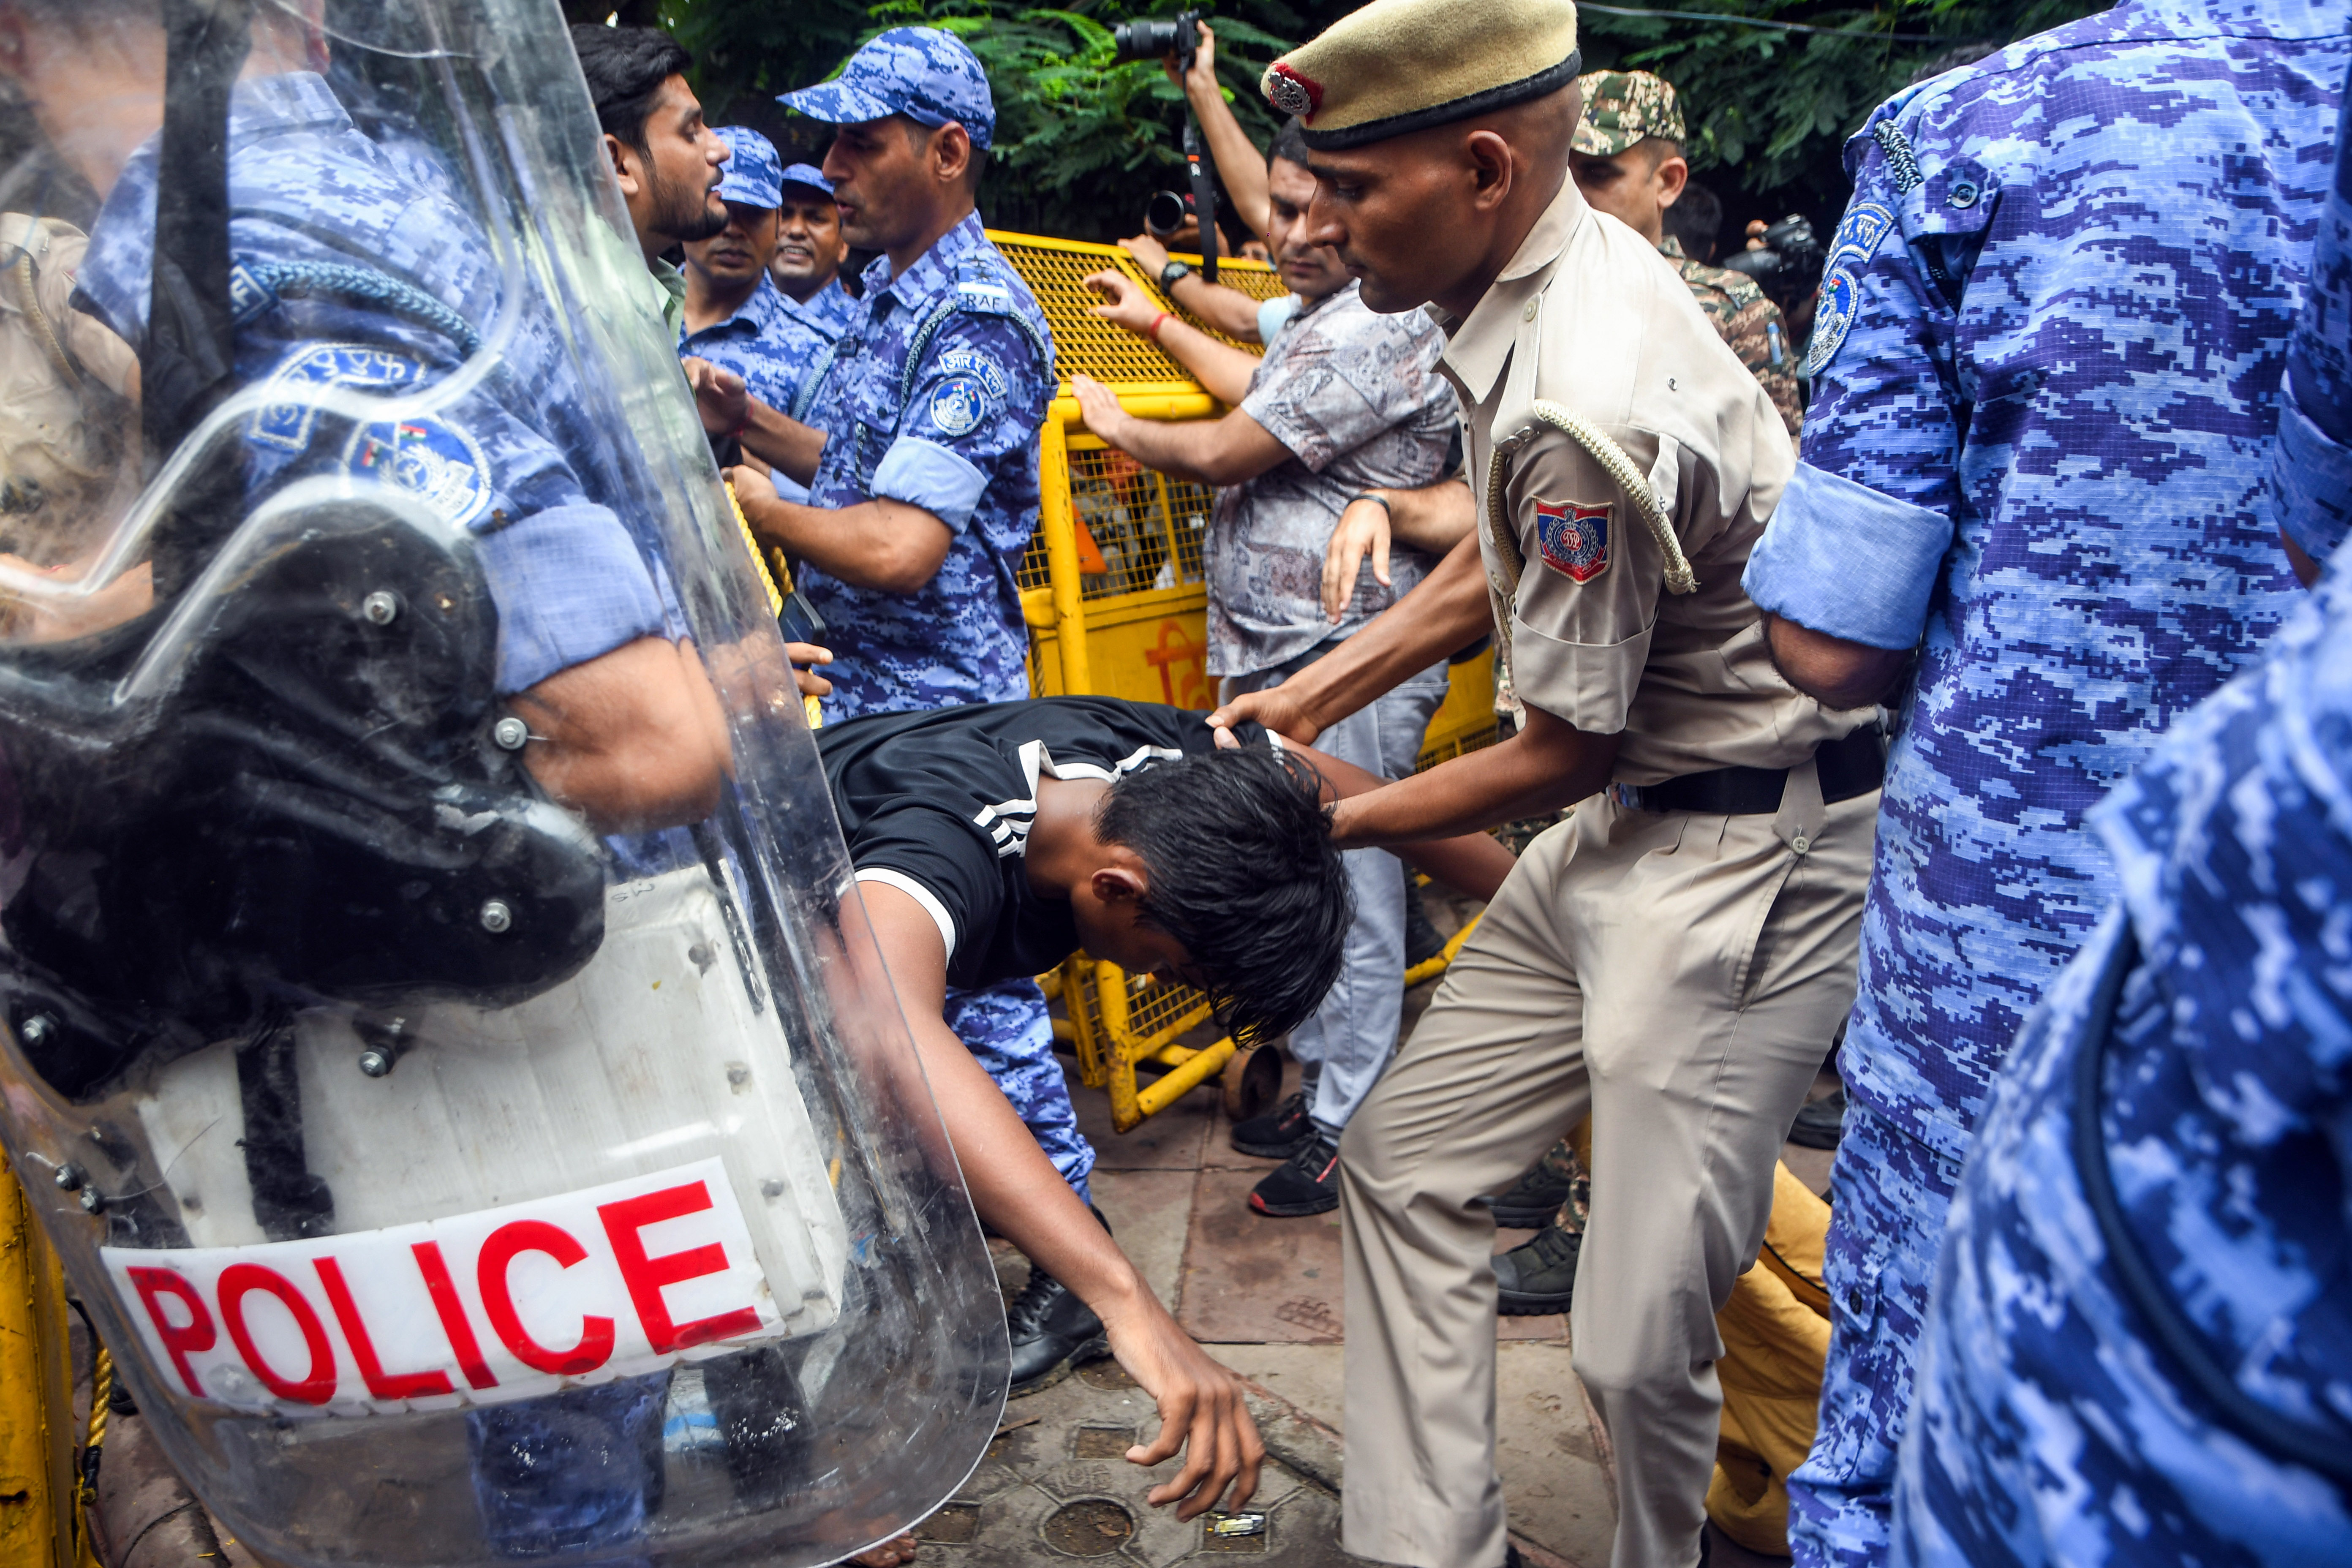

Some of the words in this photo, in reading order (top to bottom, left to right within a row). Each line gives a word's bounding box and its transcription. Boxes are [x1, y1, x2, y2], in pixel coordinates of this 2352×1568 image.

[966, 294, 1000, 310] RAF
[946, 354, 972, 369] आर
[974, 357, 986, 374] ए
[127, 1180, 763, 1405] POLICE
